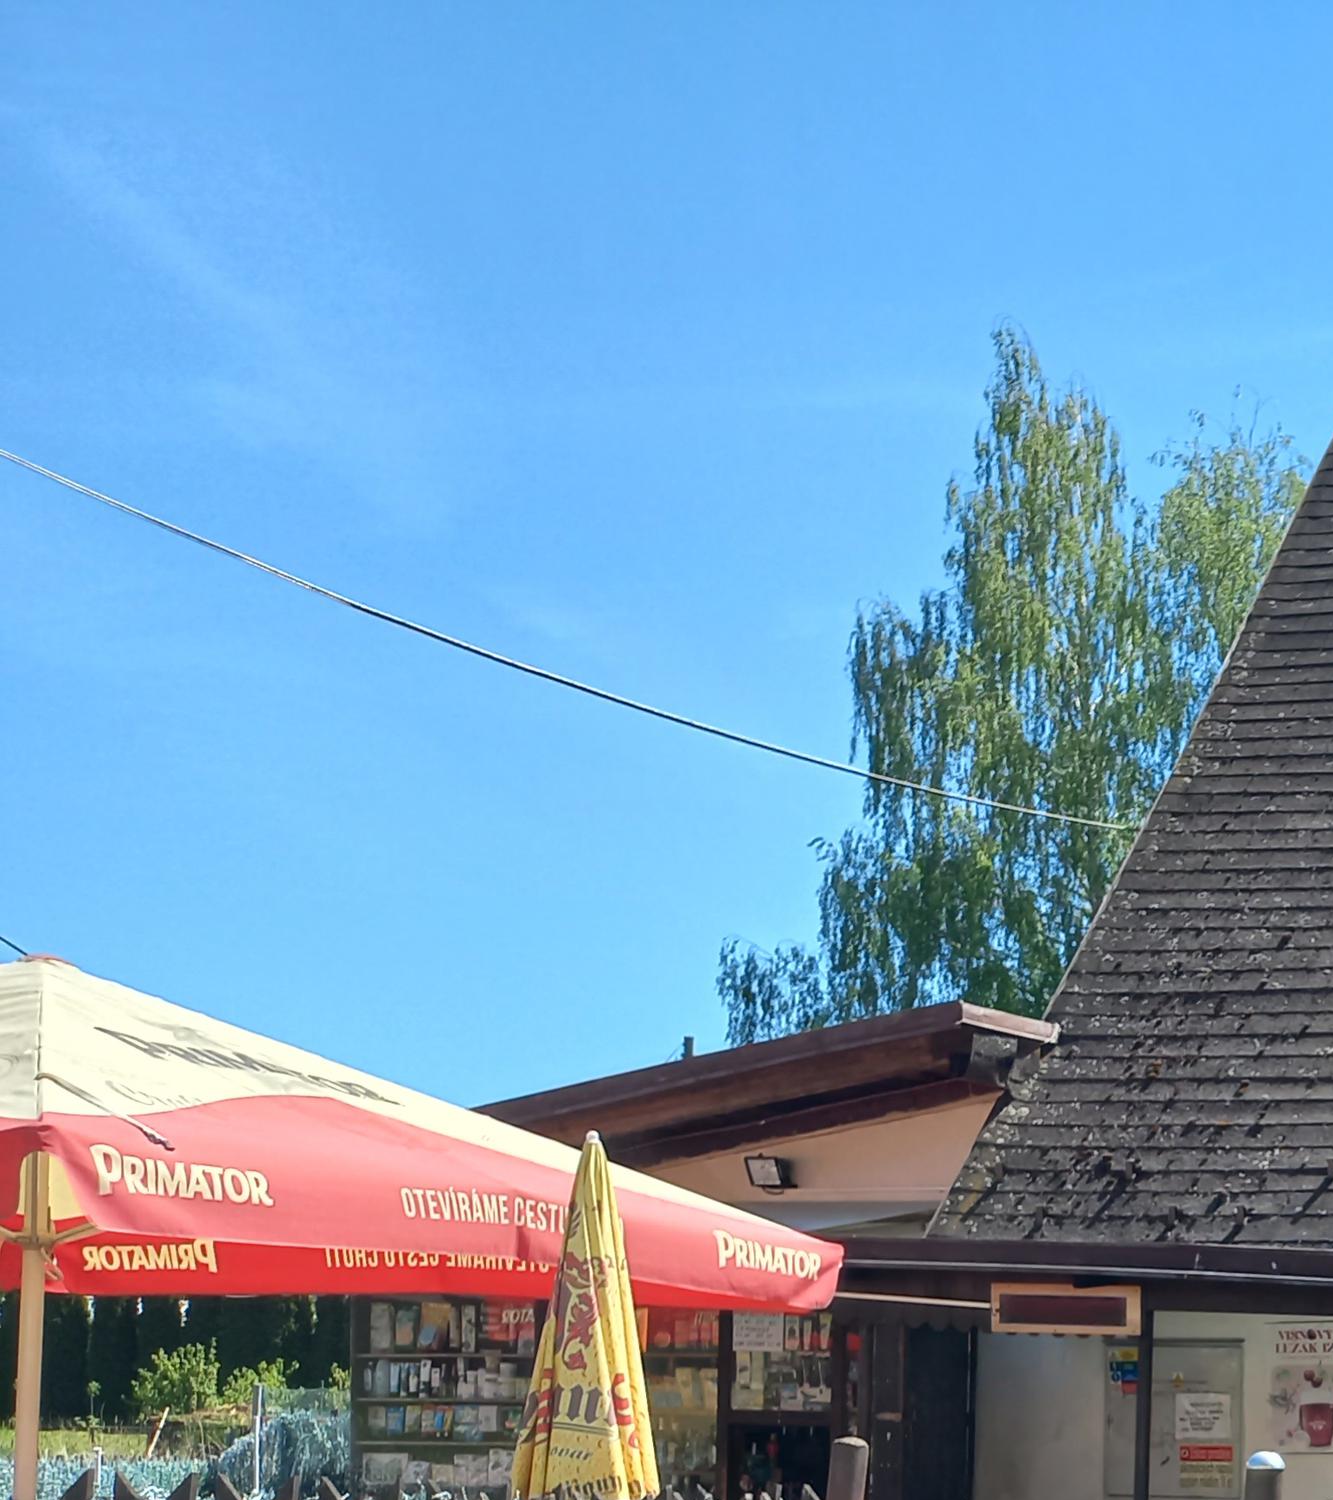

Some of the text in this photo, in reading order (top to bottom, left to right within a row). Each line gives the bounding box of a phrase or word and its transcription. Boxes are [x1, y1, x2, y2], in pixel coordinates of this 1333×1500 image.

[89, 1143, 275, 1207] PRIMATOR
[400, 1186, 509, 1225] OTEVÍRÁME
[712, 1228, 822, 1281] PRIMATOR
